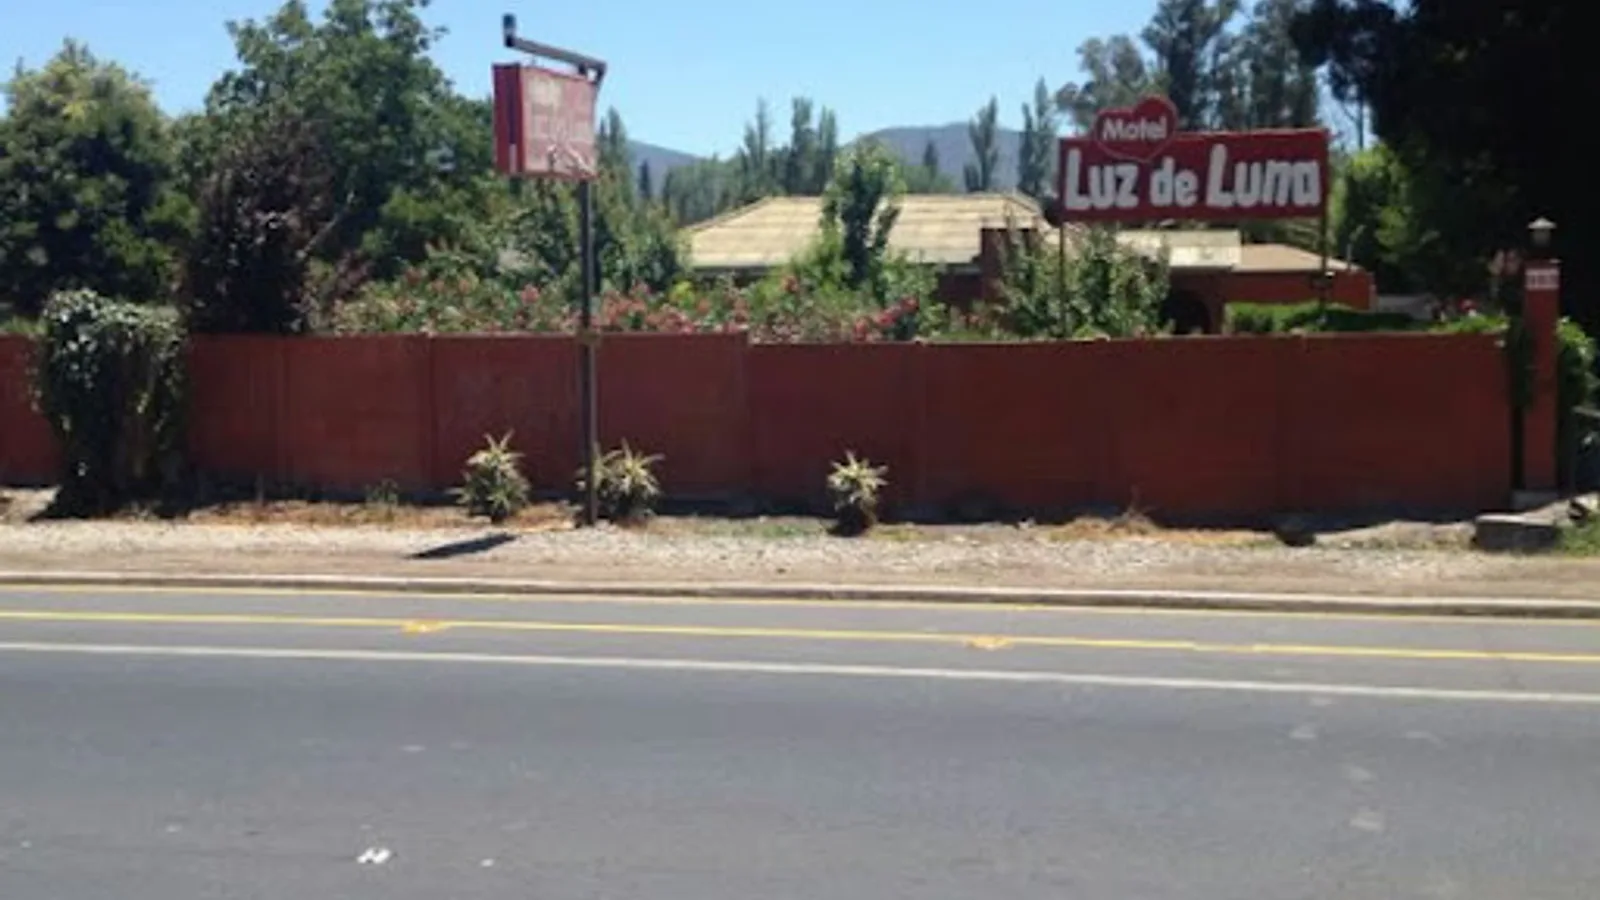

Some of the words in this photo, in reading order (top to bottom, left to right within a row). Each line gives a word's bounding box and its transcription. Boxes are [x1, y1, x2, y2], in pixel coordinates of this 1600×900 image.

[1102, 116, 1168, 141] Motel
[1065, 148, 1139, 210] Luz
[1150, 156, 1199, 207] de
[1206, 144, 1321, 208] Luna
